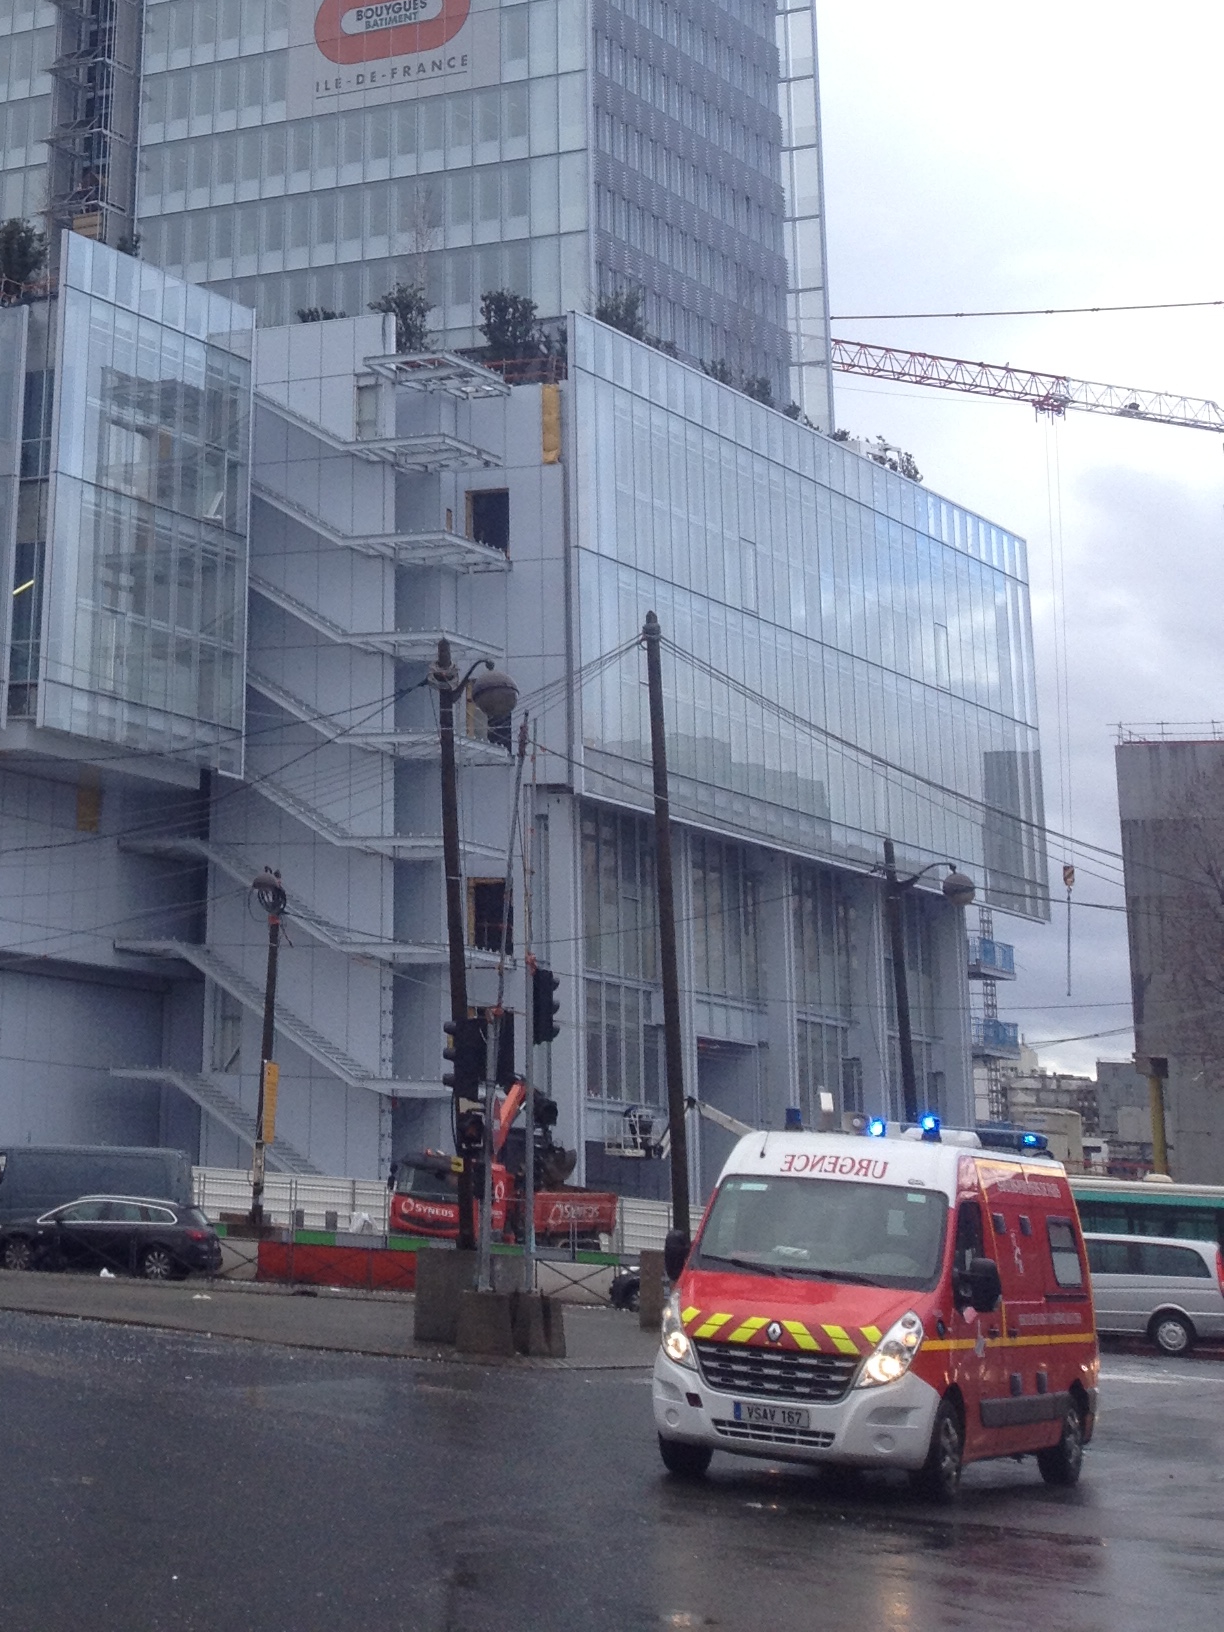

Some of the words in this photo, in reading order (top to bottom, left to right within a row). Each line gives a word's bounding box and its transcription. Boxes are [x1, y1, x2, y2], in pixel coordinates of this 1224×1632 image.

[365, 11, 418, 30] BATIMENT
[747, 1406, 776, 1421] VSAV
[781, 1410, 802, 1425] 167
